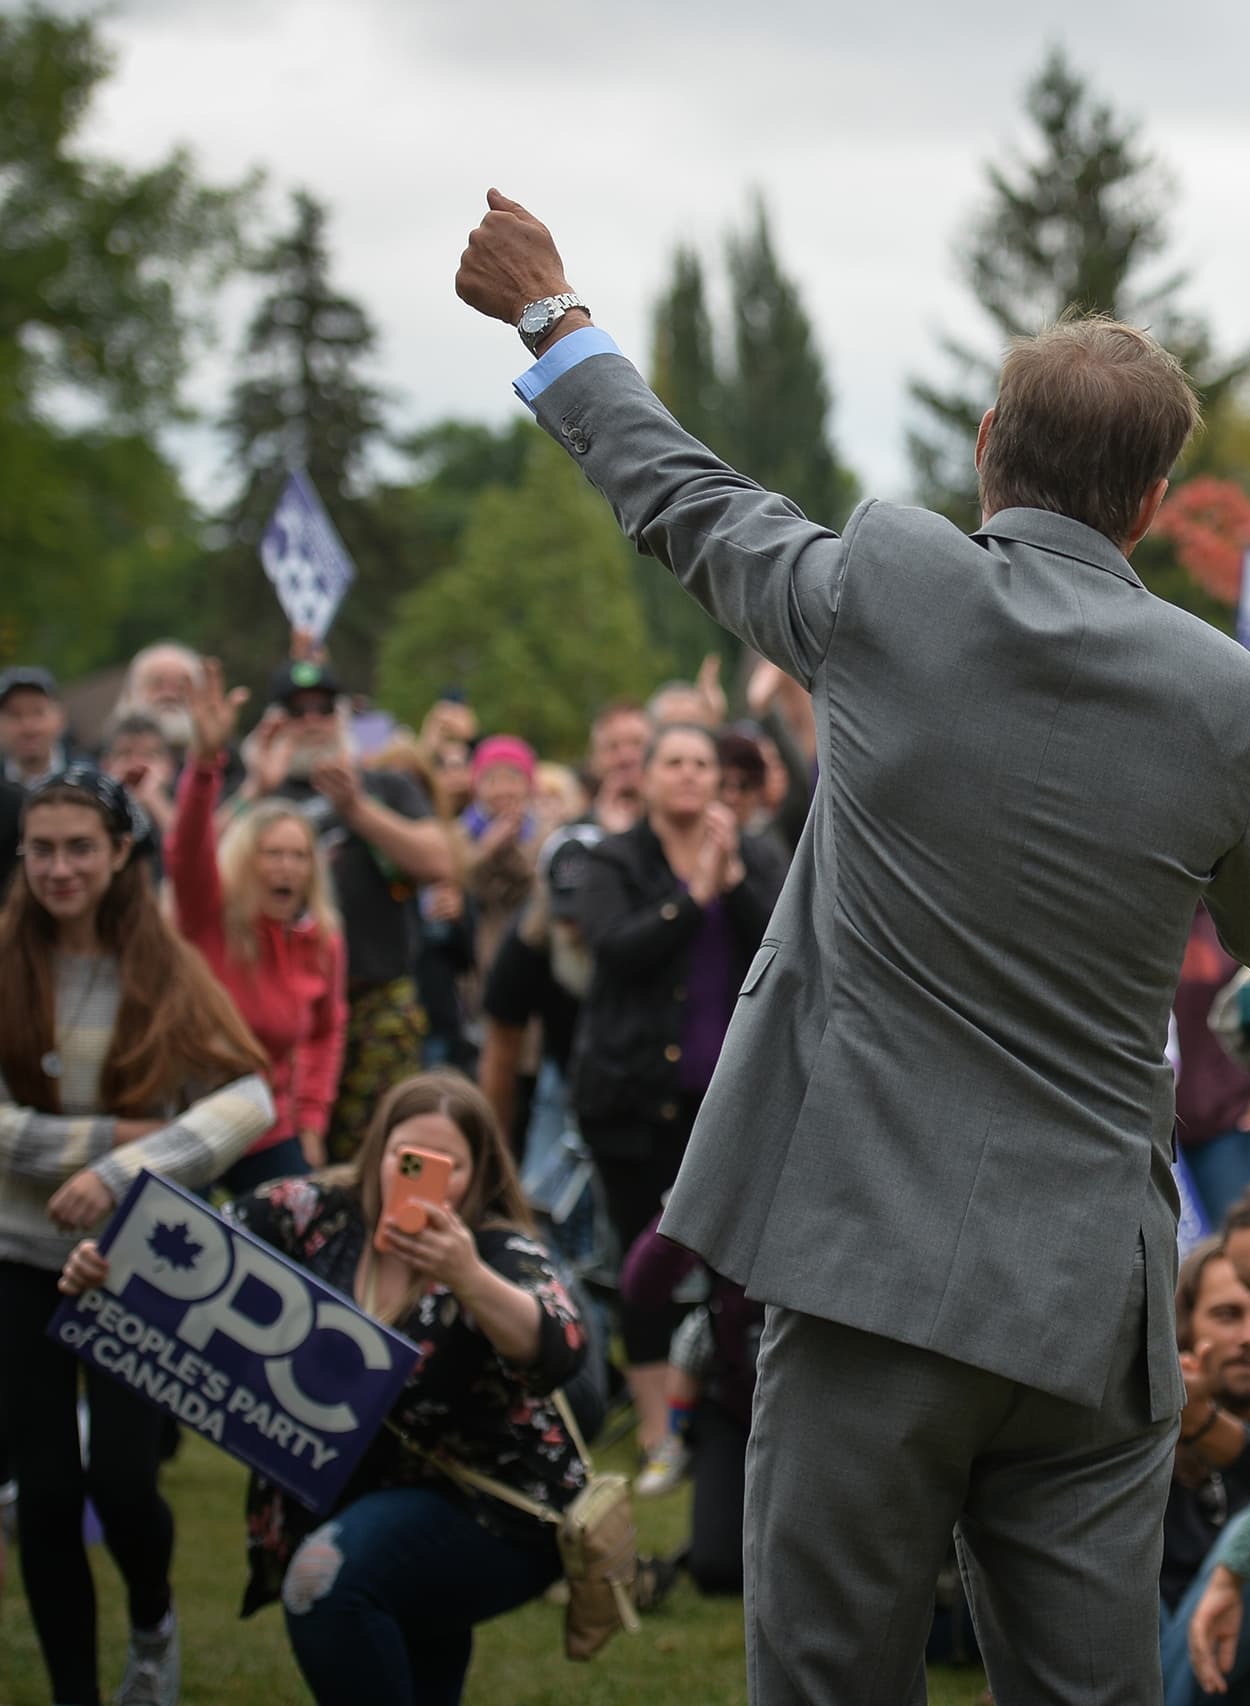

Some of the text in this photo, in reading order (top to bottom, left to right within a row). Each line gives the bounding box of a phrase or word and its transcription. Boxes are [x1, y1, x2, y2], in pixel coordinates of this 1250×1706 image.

[59, 1322, 224, 1441] of CANADA
[77, 1290, 339, 1470] PEOPLE'S PARTY
[100, 1179, 392, 1432] PPC
